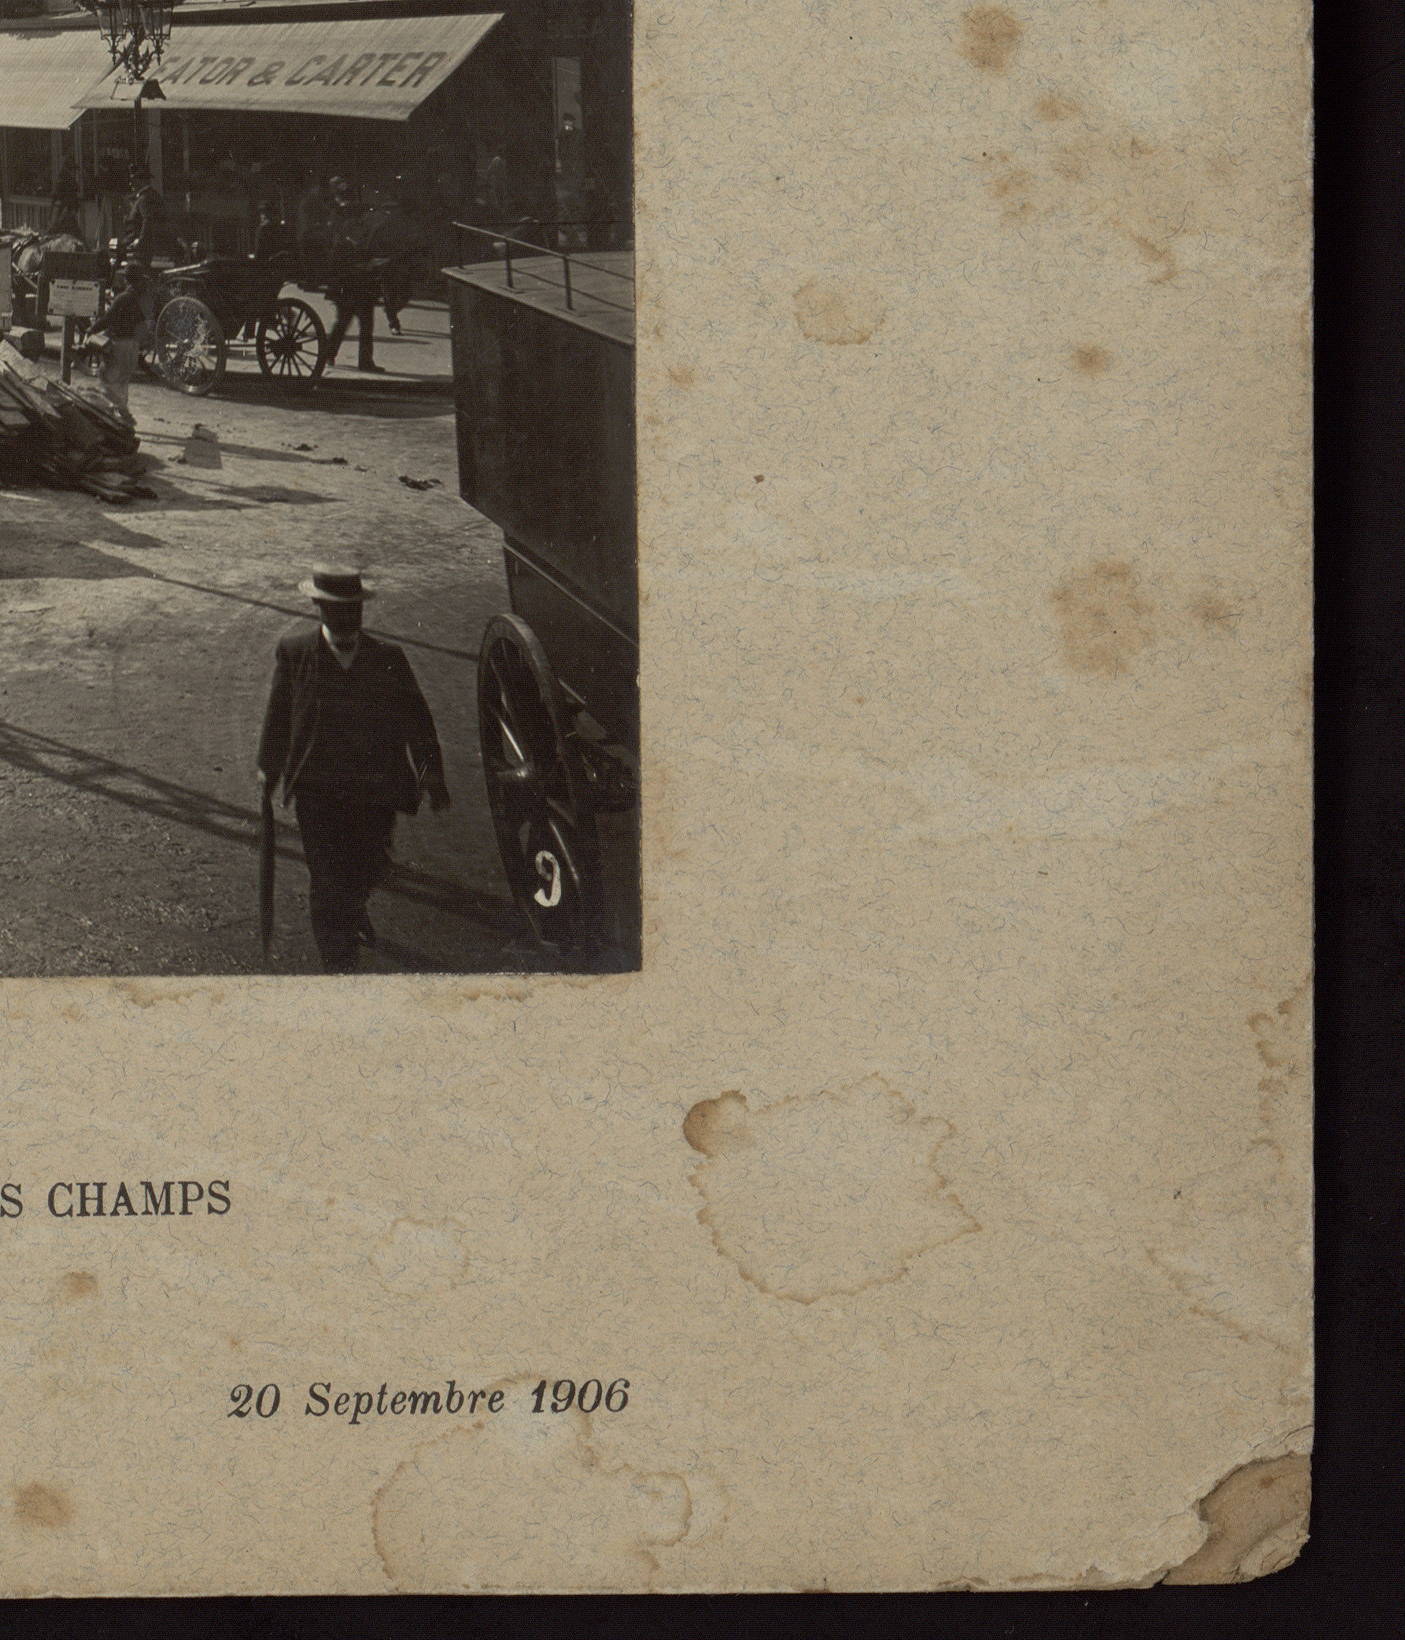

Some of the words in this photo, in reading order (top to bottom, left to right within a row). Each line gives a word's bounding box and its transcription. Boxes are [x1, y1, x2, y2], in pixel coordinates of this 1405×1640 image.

[246, 60, 286, 88] &
[285, 51, 448, 88] CARTER
[534, 850, 561, 907] 9
[47, 1179, 232, 1219] CHAMPS
[226, 1383, 281, 1419] 20
[304, 1378, 515, 1429] Septembre
[531, 1377, 631, 1415] 1906
